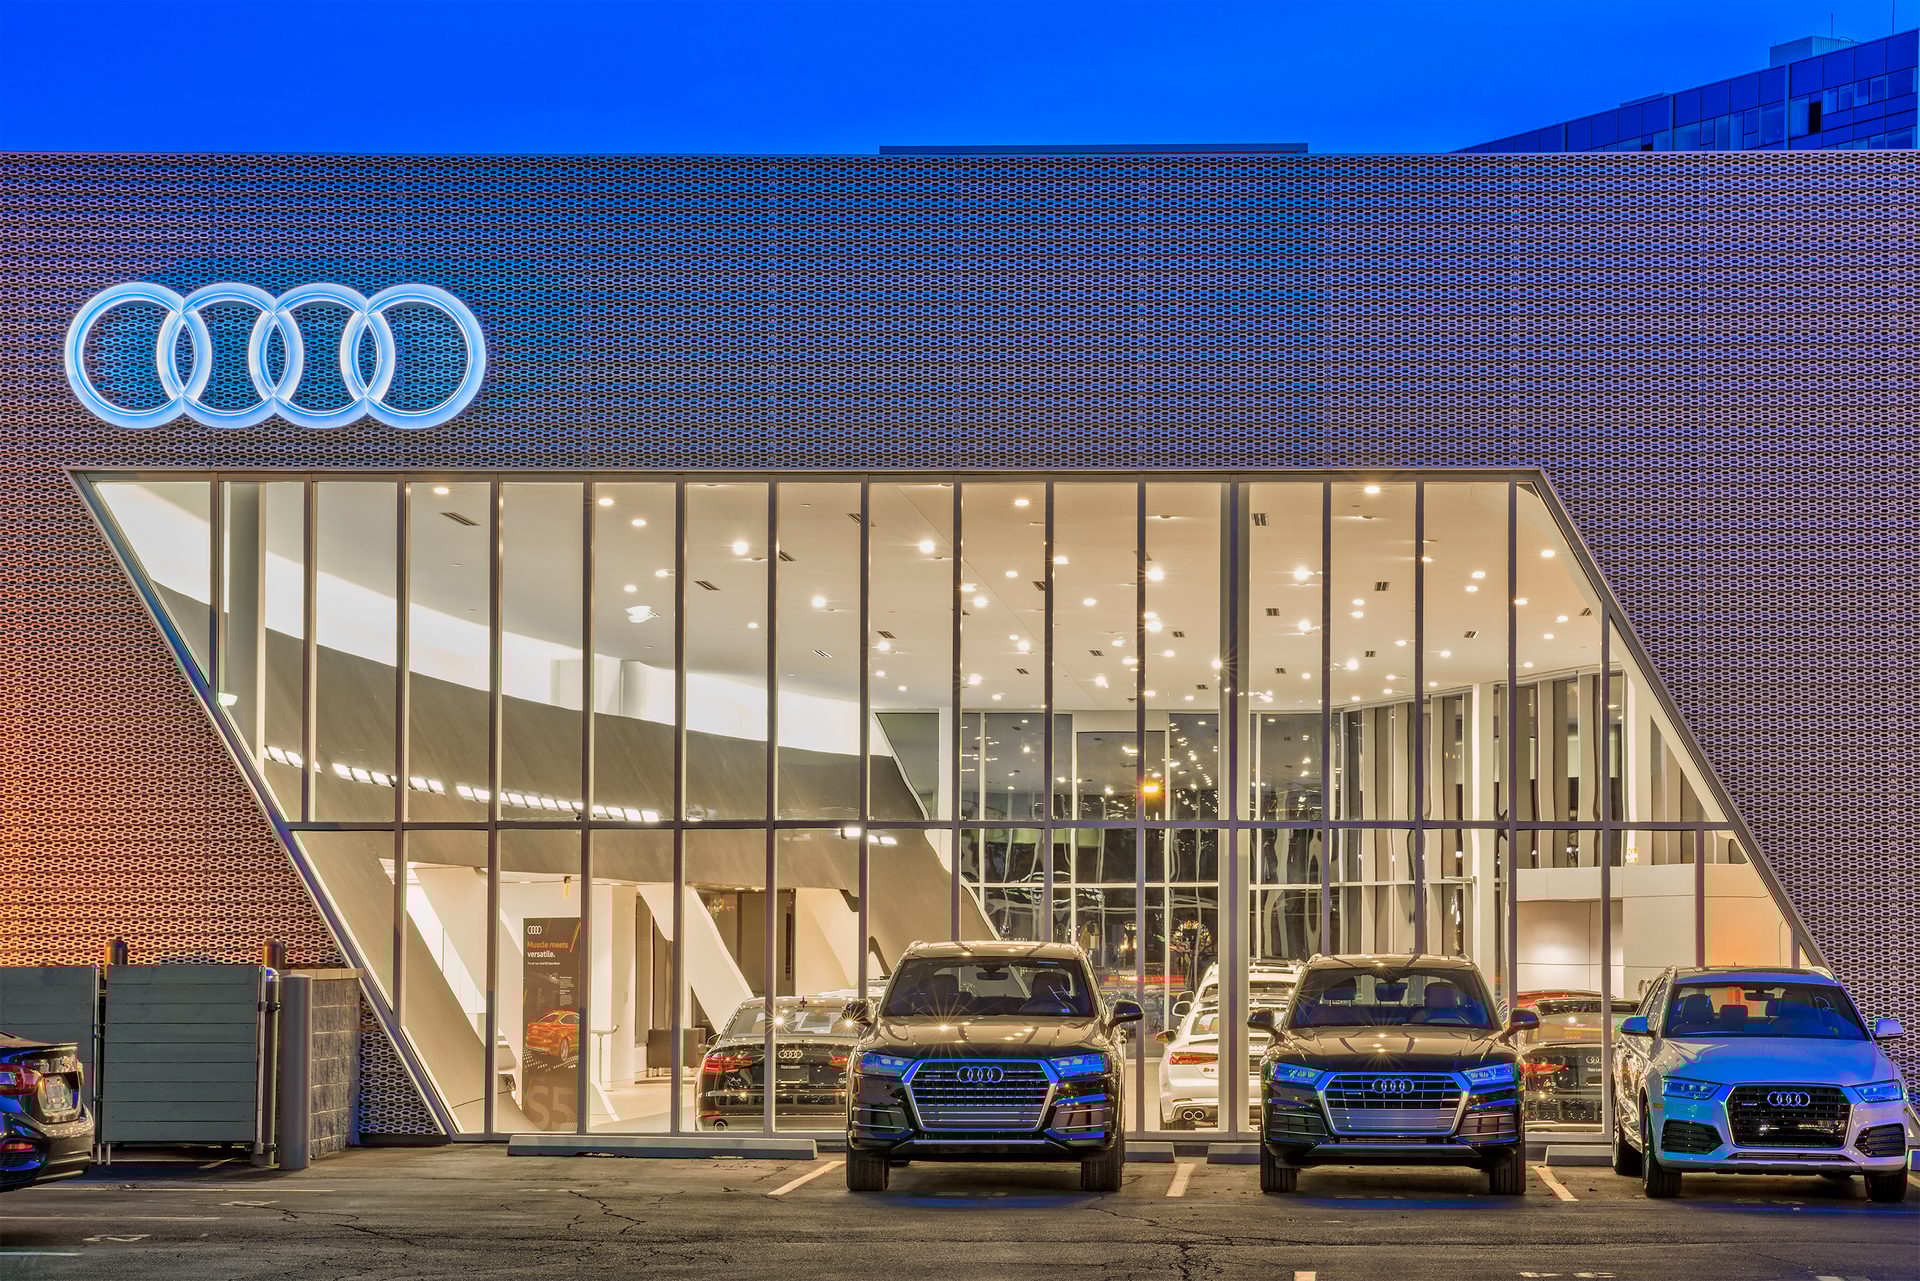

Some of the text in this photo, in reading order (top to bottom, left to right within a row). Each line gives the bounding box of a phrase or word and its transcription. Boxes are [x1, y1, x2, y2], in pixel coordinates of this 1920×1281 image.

[527, 941, 569, 949] Muscle meets
[527, 950, 556, 958] versatile.
[527, 1085, 577, 1131] S5
